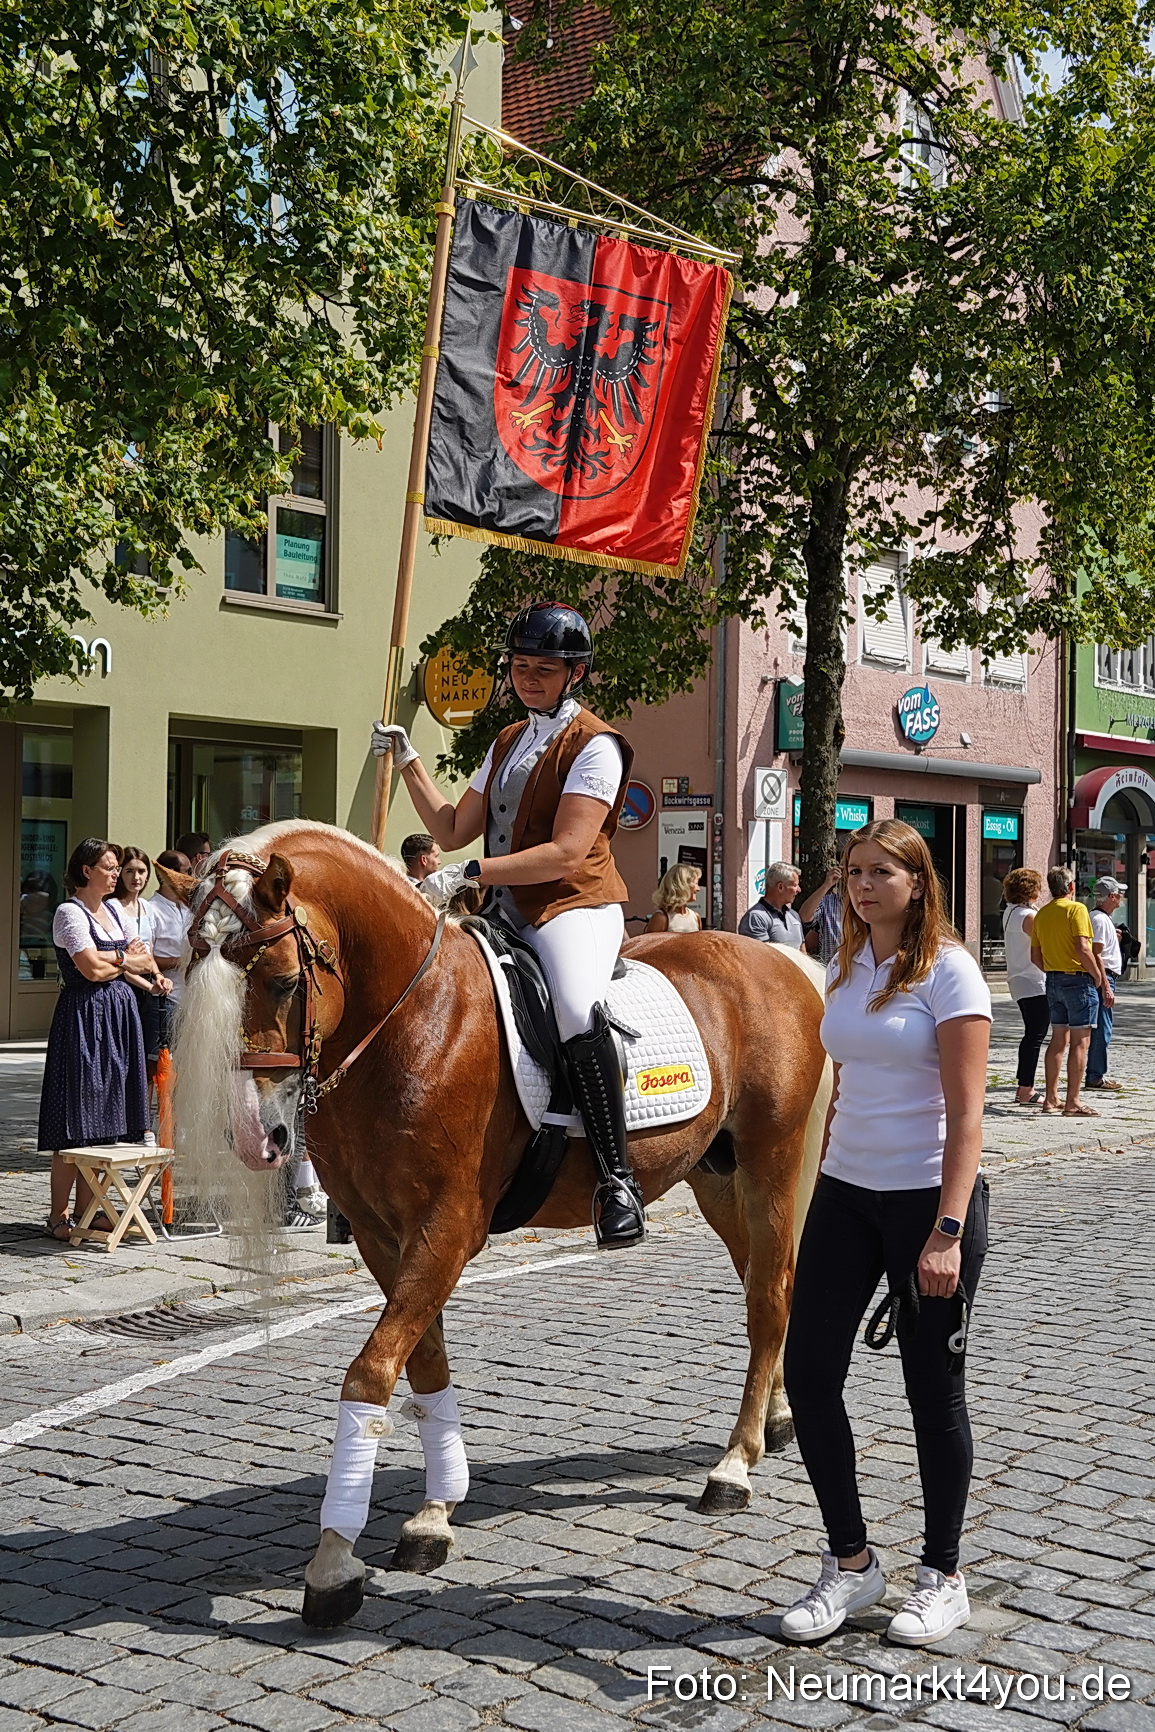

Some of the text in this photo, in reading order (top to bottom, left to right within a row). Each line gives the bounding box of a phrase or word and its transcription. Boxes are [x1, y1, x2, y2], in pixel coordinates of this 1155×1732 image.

[284, 539, 310, 551] Planung
[284, 549, 318, 563] Bauleitung
[441, 675, 468, 687] NEU
[441, 687, 487, 702] MARKT
[897, 692, 921, 715] vom
[905, 704, 940, 737] FASS
[664, 796, 711, 807] Bockwirtsgasse
[763, 807, 779, 816] ZONE
[840, 806, 868, 826] Whisky
[985, 817, 1014, 834] Essig Öl
[641, 1072, 690, 1091] Josera
